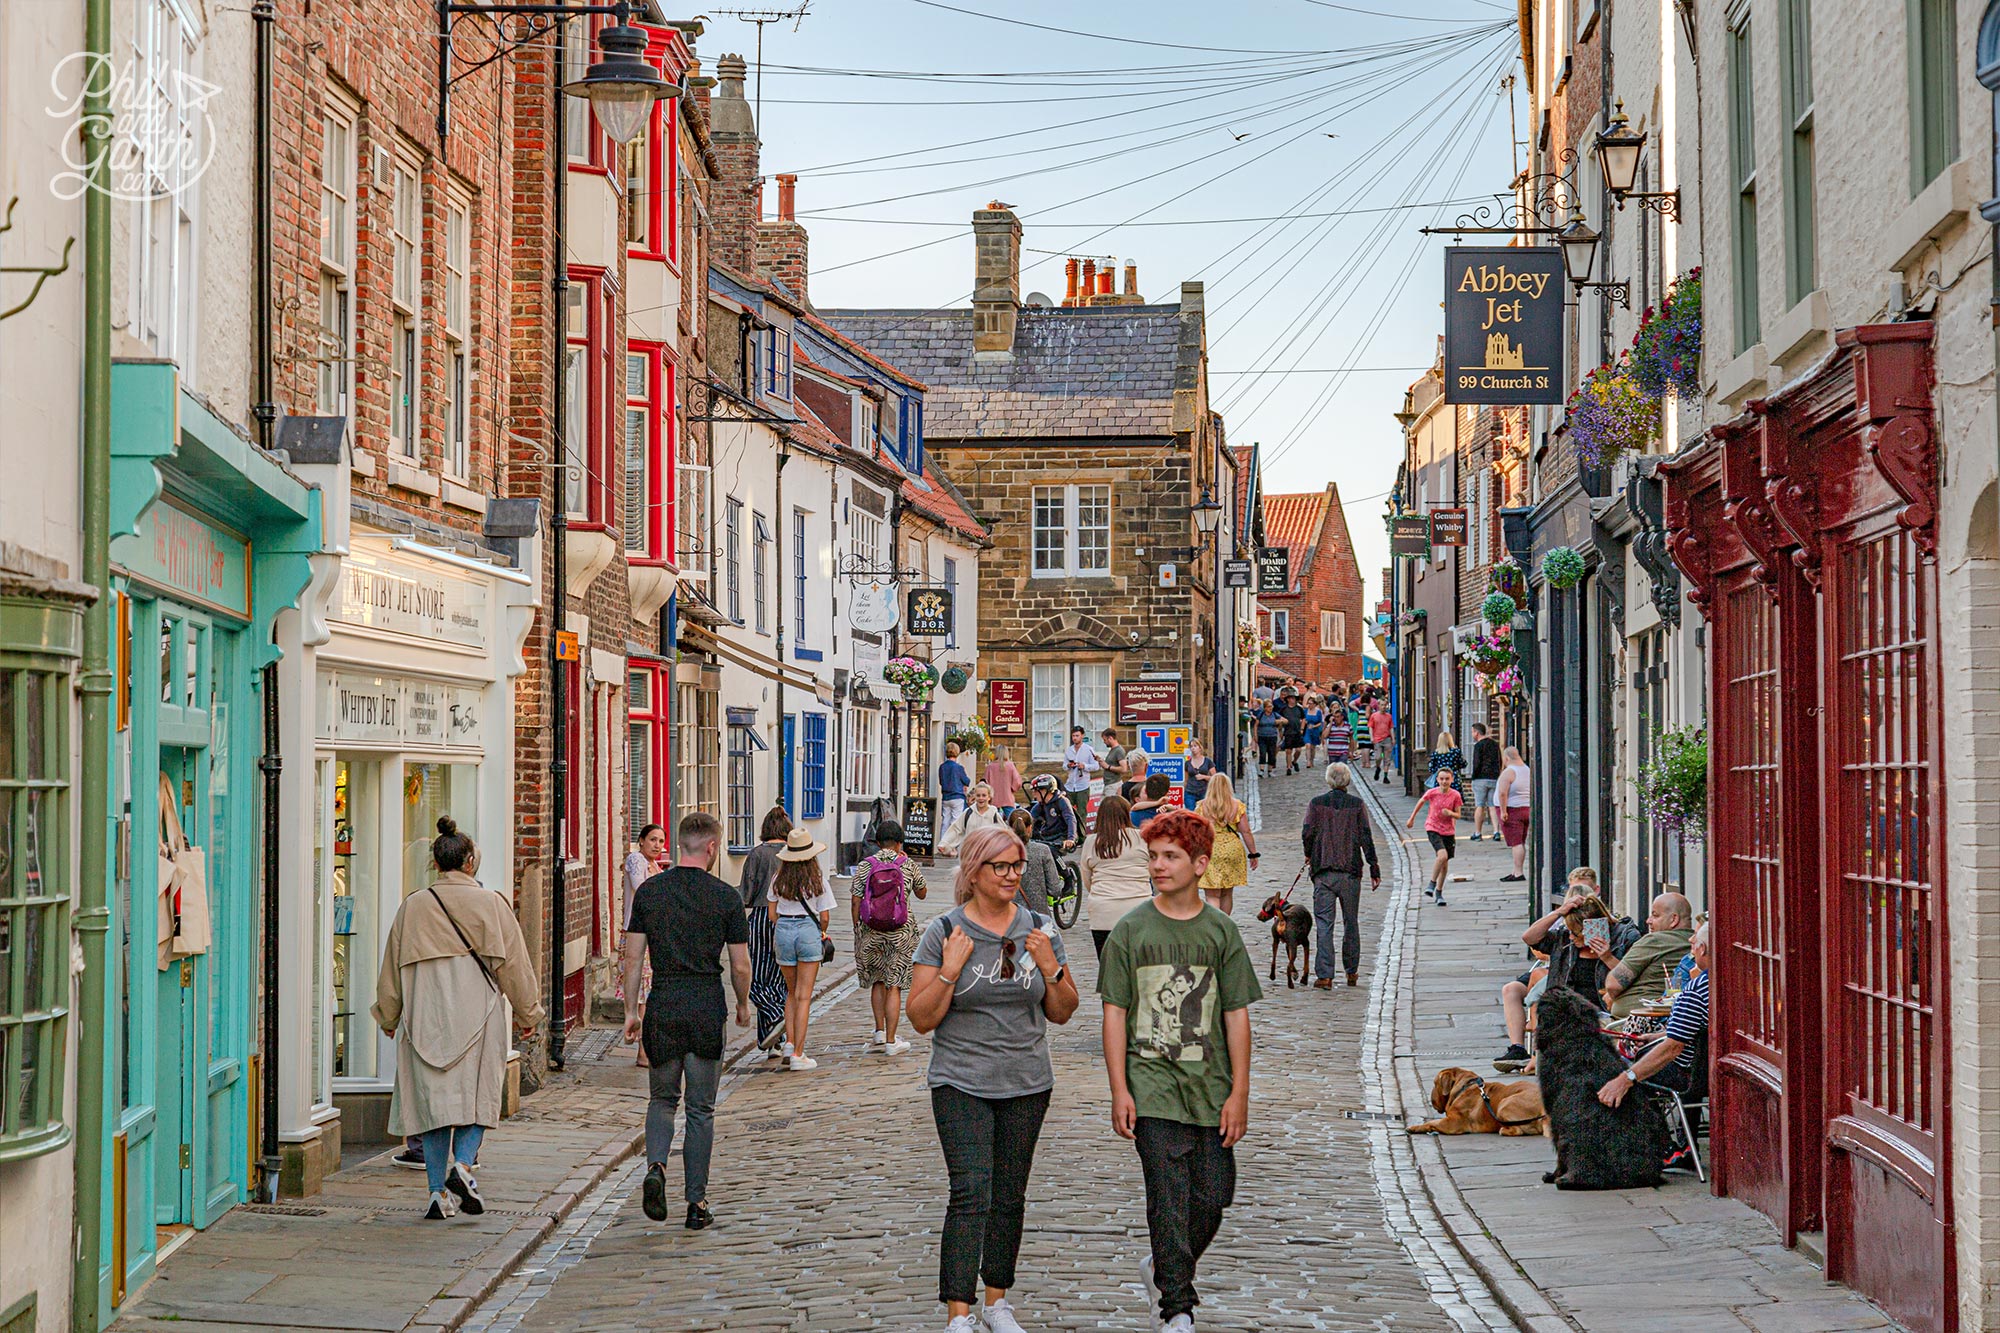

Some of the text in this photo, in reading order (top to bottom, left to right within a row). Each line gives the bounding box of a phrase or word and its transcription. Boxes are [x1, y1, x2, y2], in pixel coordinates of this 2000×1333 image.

[1457, 264, 1550, 299] Abbey
[1481, 298, 1523, 330] Jet
[1459, 375, 1549, 389] 99 Church St
[1436, 524, 1463, 532] Whitby
[1260, 557, 1287, 566] BOARD
[352, 567, 445, 621] WHITBY JET STORE
[913, 620, 945, 629] EBOR
[1120, 685, 1143, 693] Whitby
[341, 690, 396, 726] WHITBY JET
[1148, 759, 1182, 767] Unsuitable
[904, 831, 923, 839] Whitby
